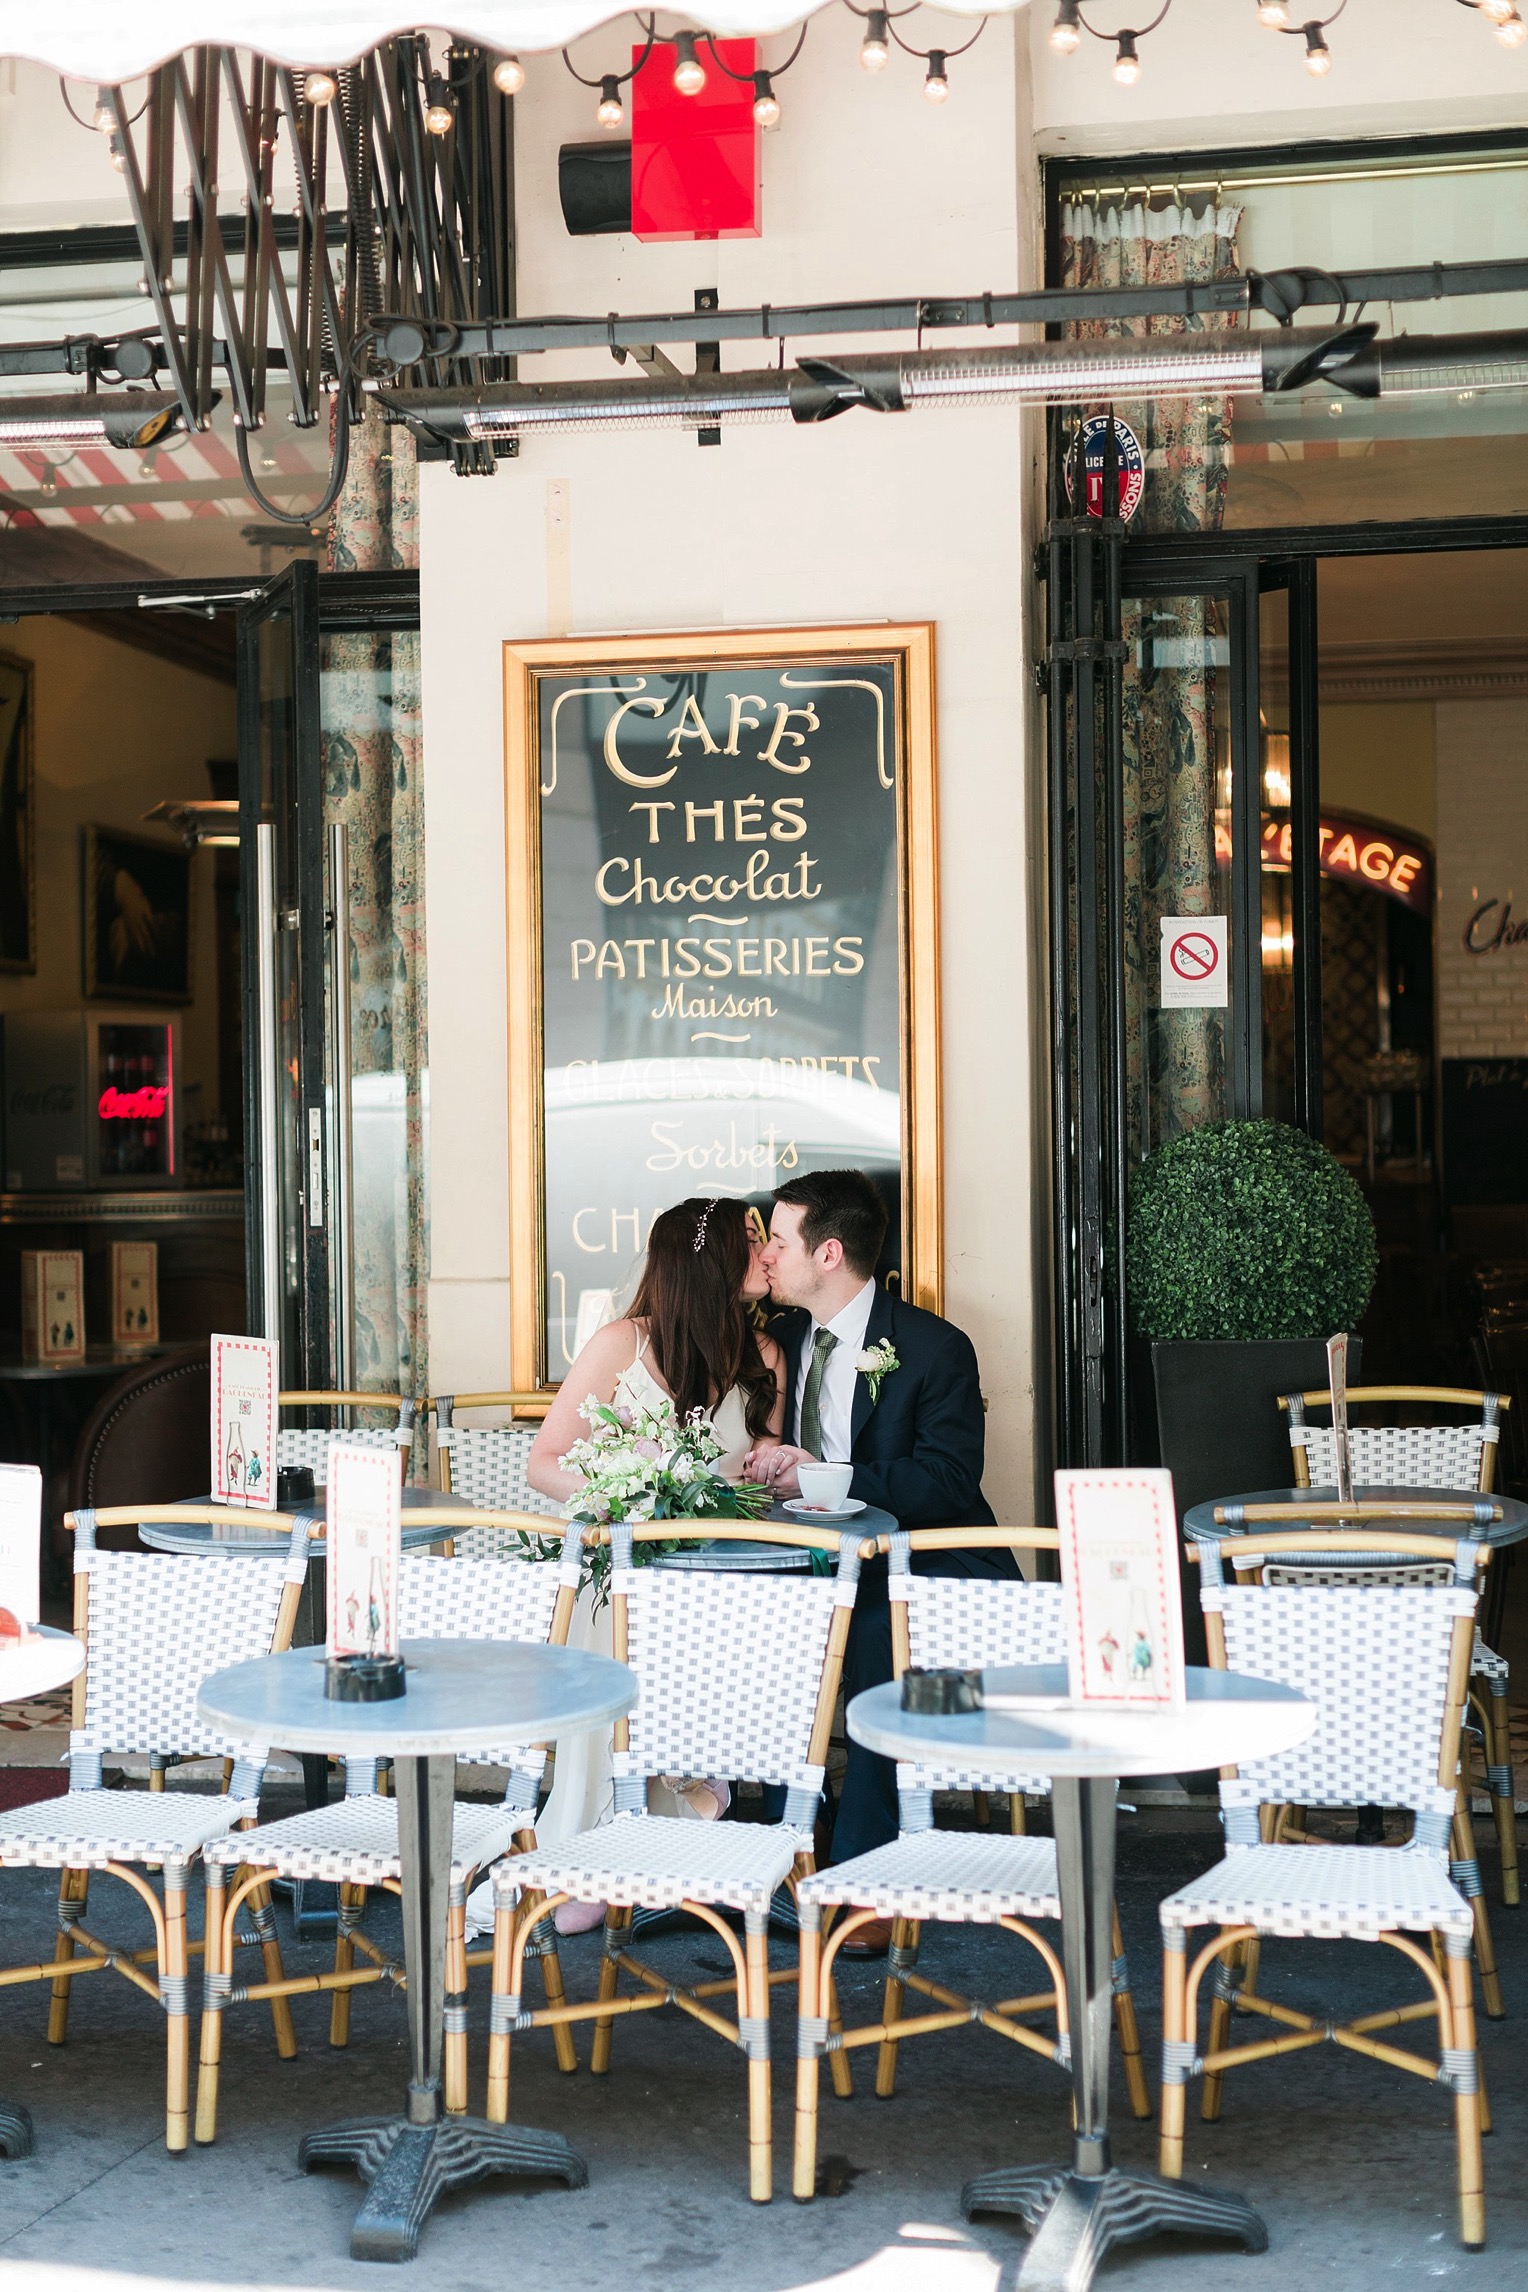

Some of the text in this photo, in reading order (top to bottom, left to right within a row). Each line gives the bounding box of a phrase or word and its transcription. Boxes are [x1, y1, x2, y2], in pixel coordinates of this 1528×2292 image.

[629, 793, 807, 843] THÉS
[595, 849, 822, 906] Chocolat
[570, 936, 865, 980] PATISSERIES
[650, 983, 778, 1020] Maison
[732, 1056, 881, 1099] SORBETS
[645, 1121, 799, 1171] Sorbets
